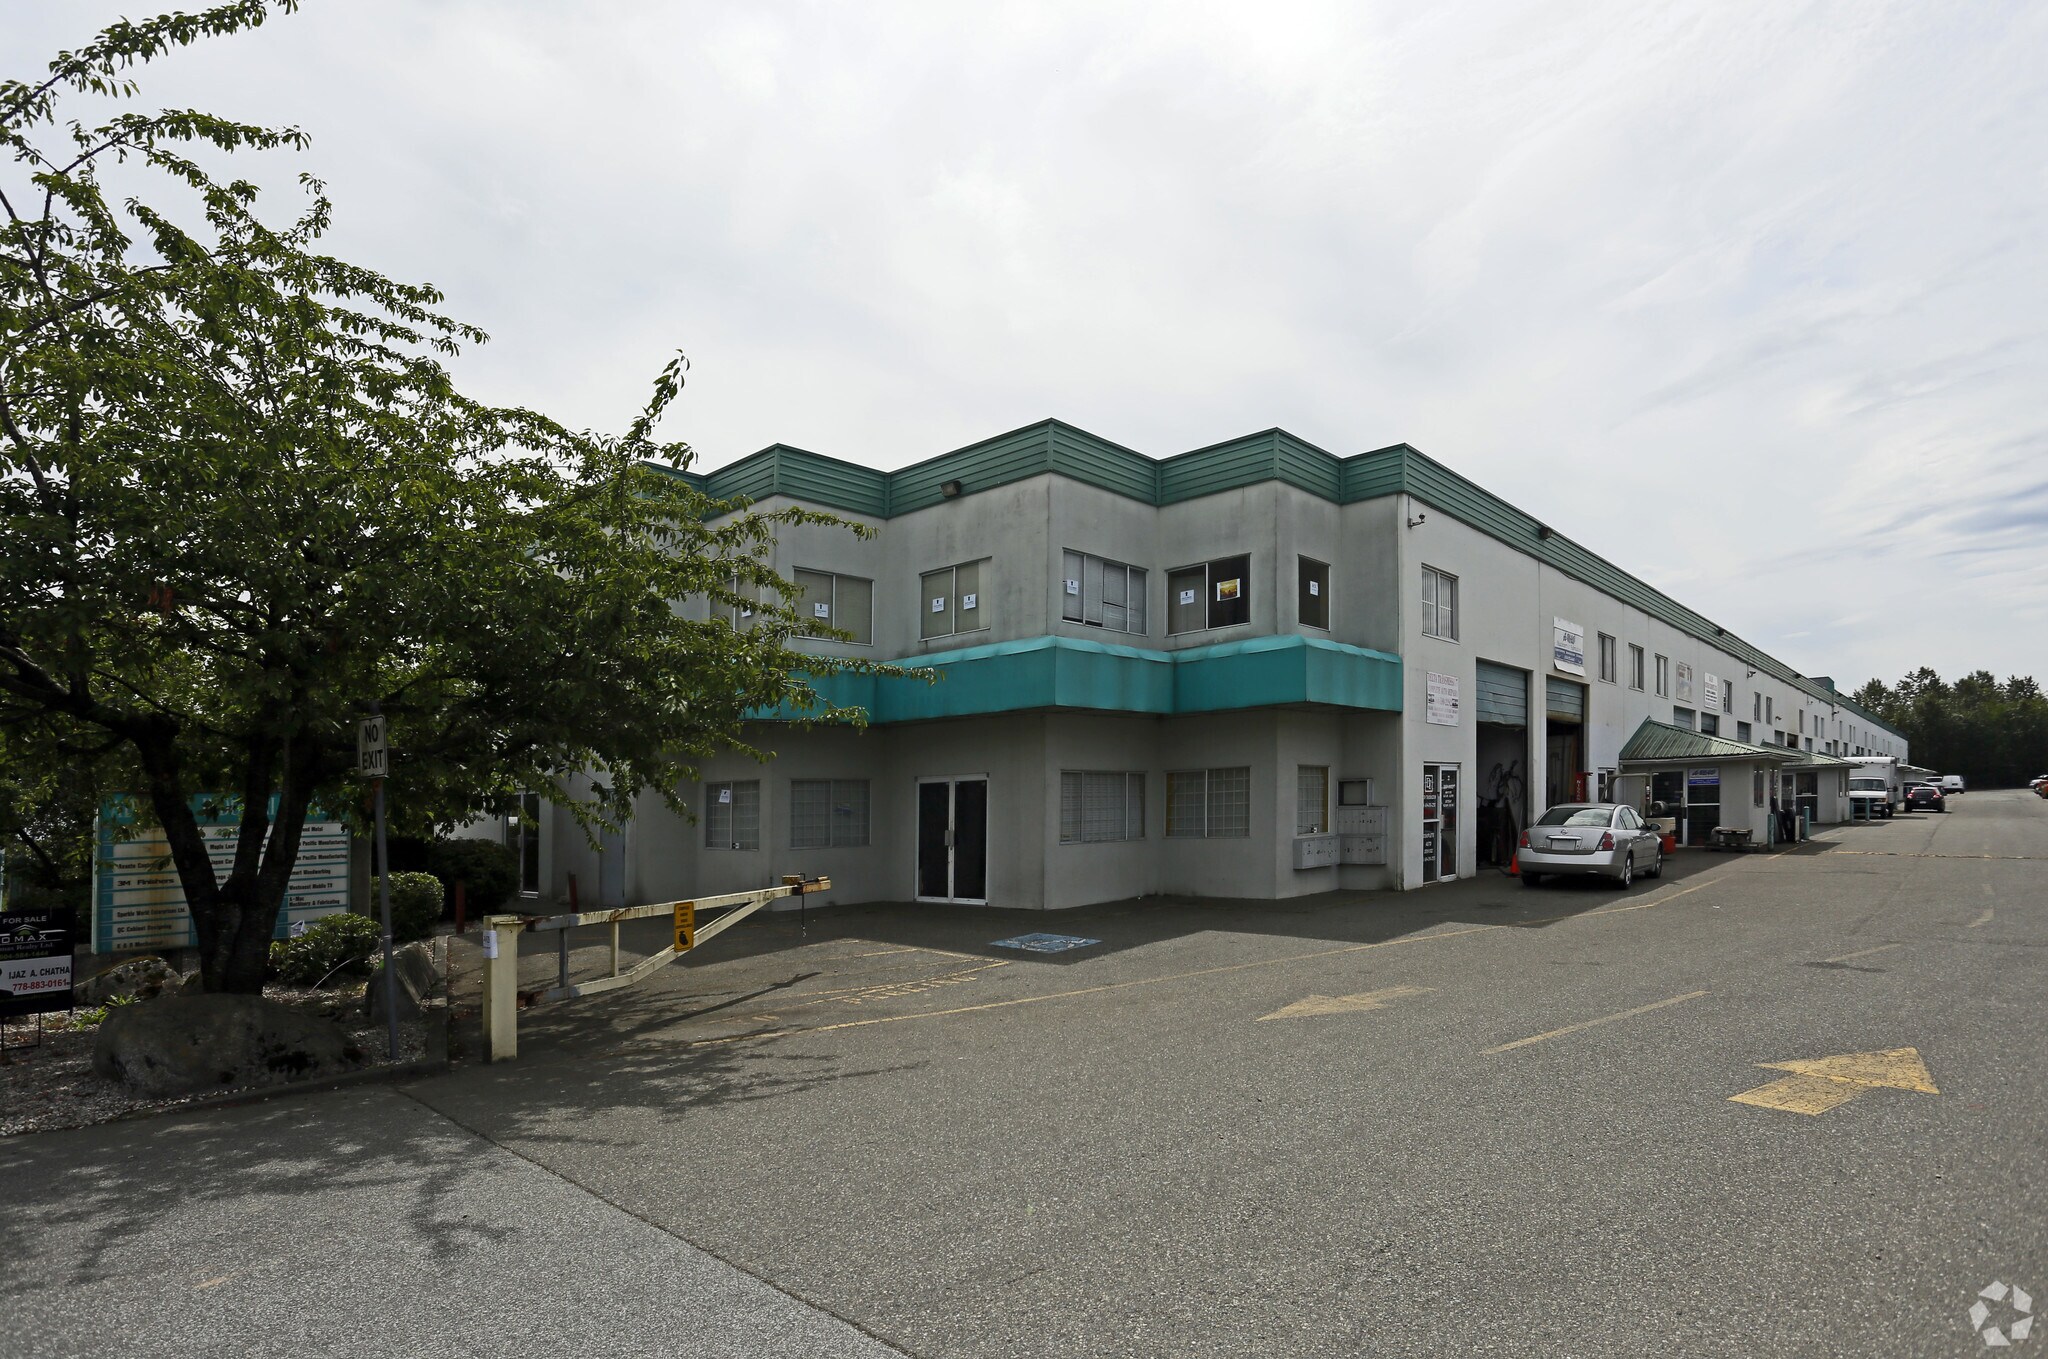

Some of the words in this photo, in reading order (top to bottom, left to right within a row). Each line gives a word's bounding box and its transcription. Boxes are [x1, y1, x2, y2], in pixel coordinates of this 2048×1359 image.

[364, 724, 379, 743] NO
[362, 748, 384, 770] EXIT
[9, 970, 26, 980] IJAZ
[30, 969, 37, 978] A.
[40, 966, 71, 976] CHATHA
[12, 978, 67, 991] 778-883-0161
